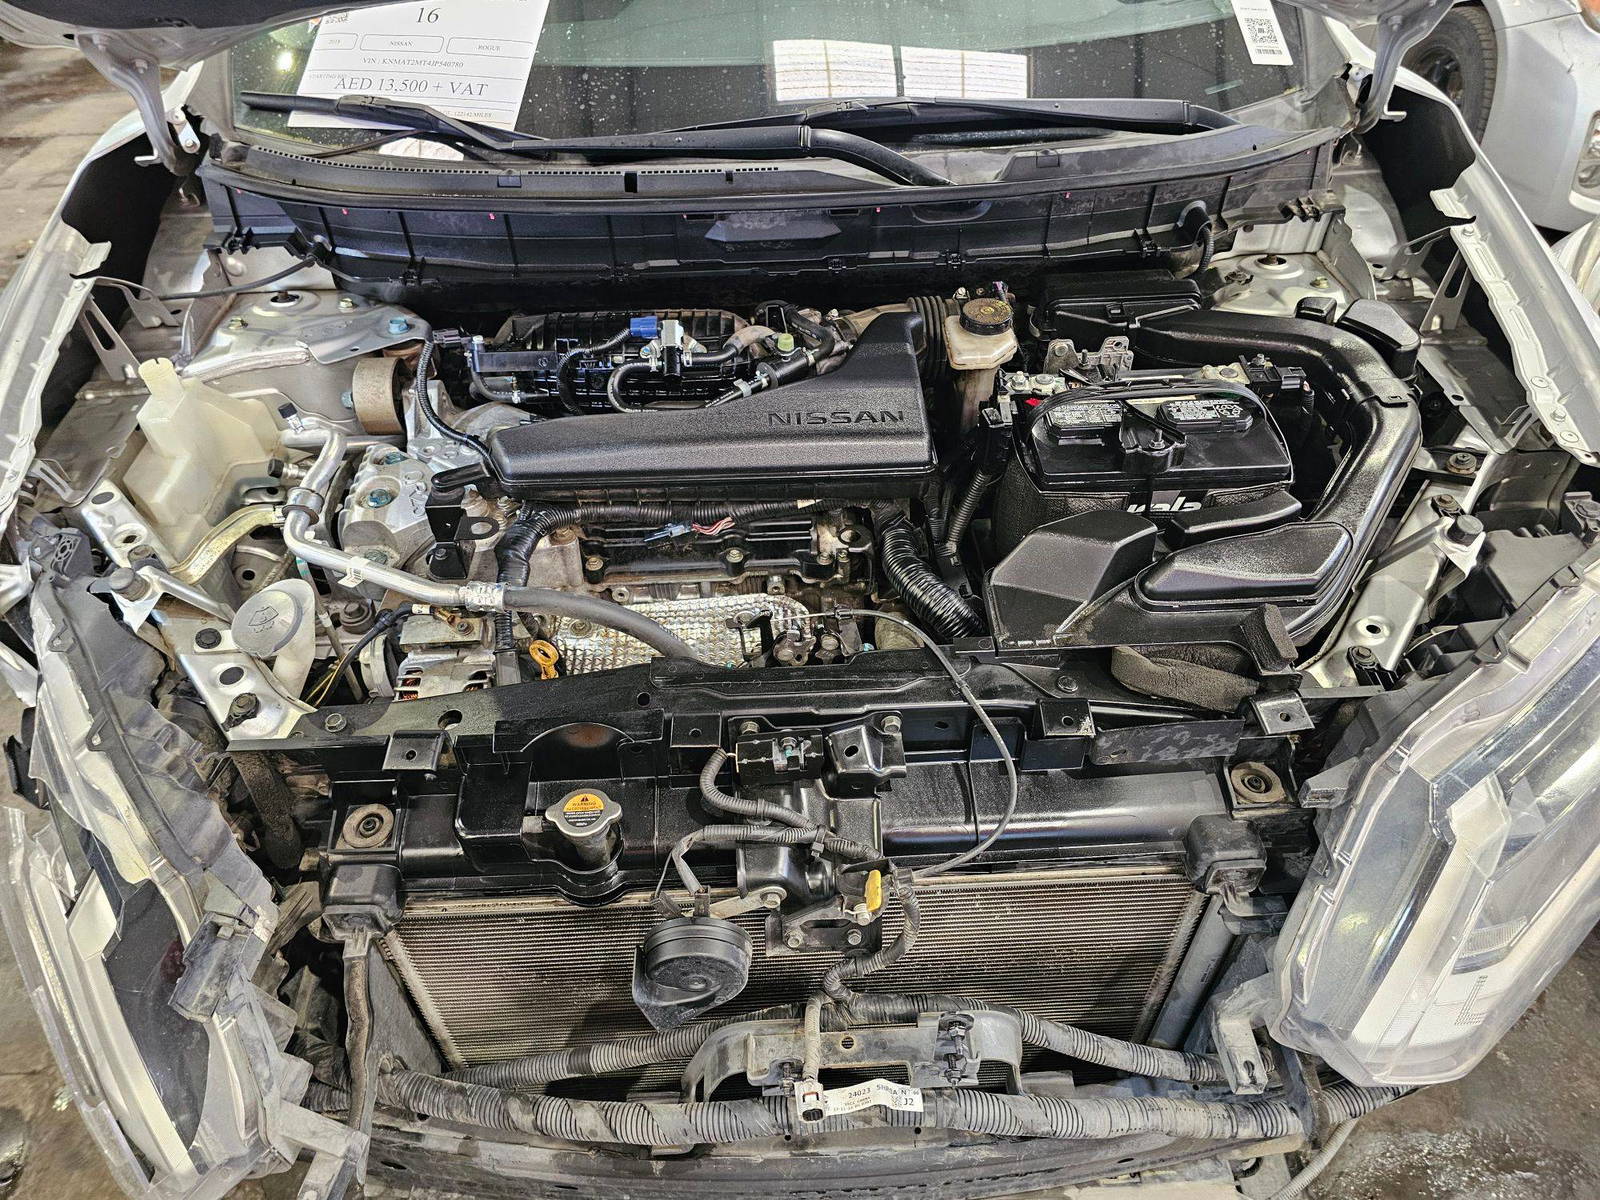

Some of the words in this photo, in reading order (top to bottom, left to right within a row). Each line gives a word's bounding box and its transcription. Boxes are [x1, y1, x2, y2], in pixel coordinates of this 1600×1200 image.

[416, 7, 441, 24] 16
[334, 76, 373, 91] AED
[378, 77, 429, 95] 13,500
[432, 82, 442, 93] +
[449, 81, 489, 97] VAT
[767, 410, 904, 426] NISSAN
[848, 1087, 871, 1099] 24023
